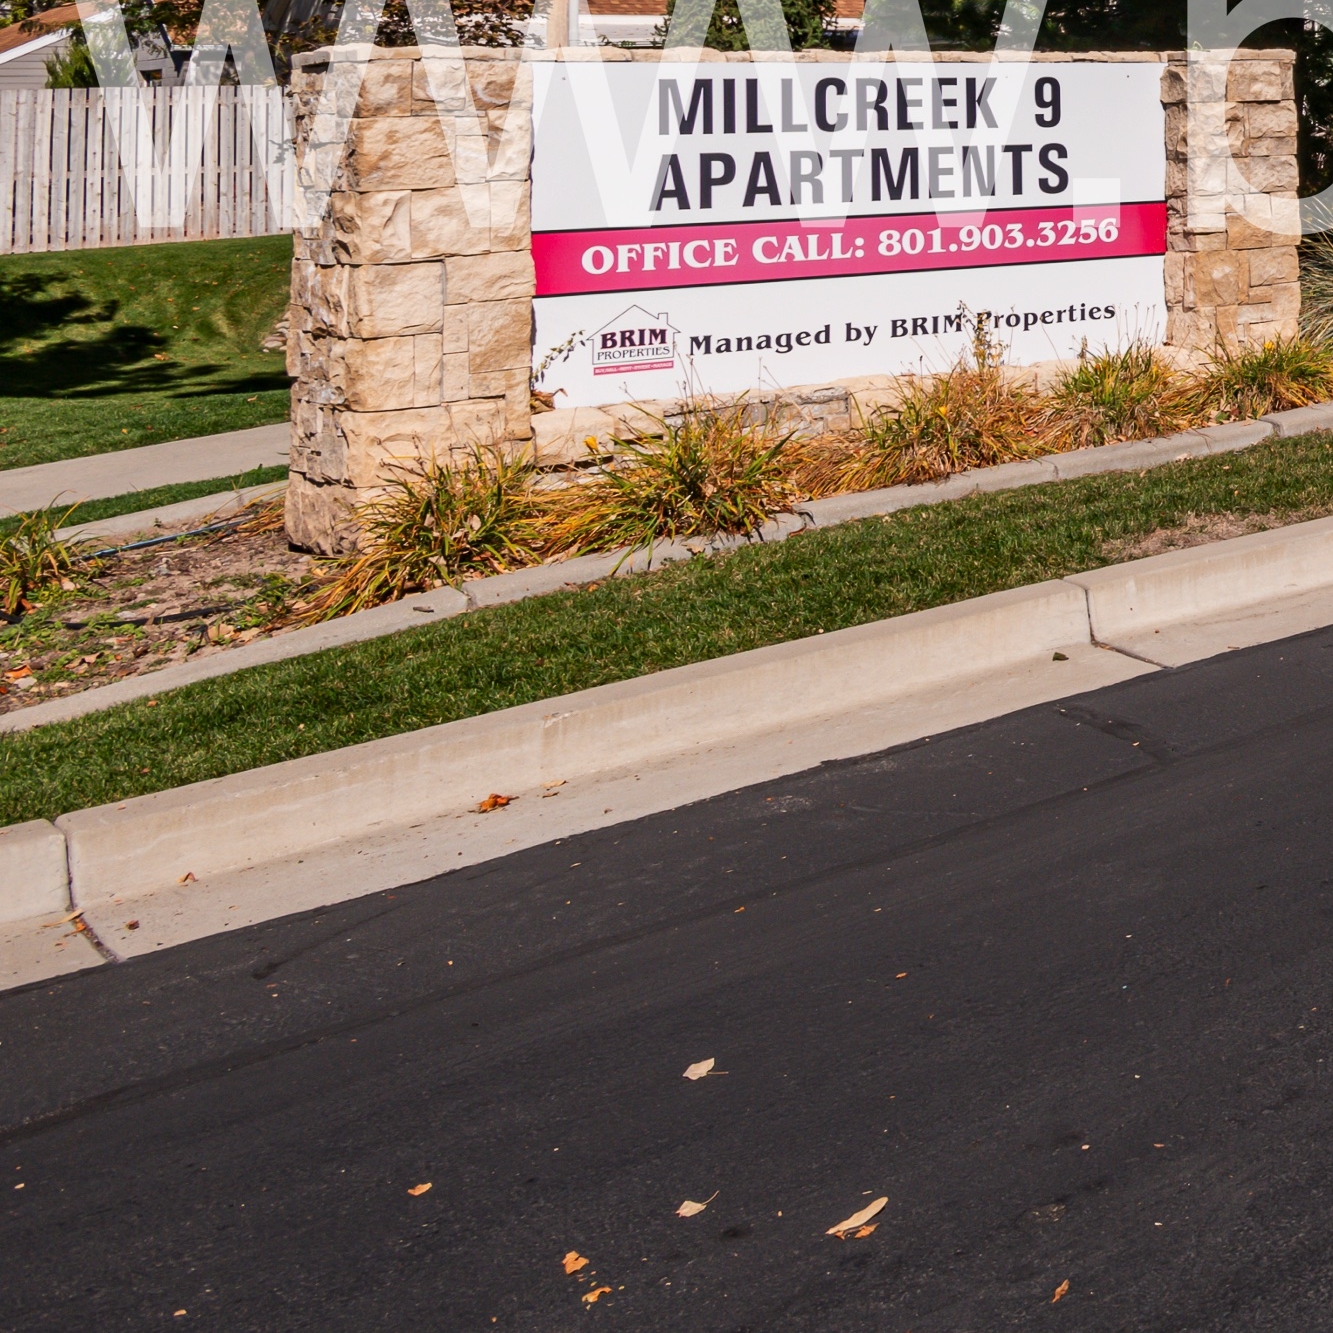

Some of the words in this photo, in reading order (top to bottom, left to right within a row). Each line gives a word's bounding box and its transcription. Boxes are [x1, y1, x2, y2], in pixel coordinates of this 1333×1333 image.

[658, 76, 999, 136] MILLCREEK
[1033, 76, 1062, 129] 9
[648, 142, 1070, 212] APARTMENTS
[581, 238, 740, 275] OFFICE
[751, 232, 866, 265] CALL:
[877, 217, 1120, 257] 801.903.3256
[597, 346, 671, 361] PROPERTIES
[600, 328, 668, 350] BRIM
[688, 323, 832, 357] Managed
[844, 321, 879, 347] by
[890, 314, 963, 339] BRIM
